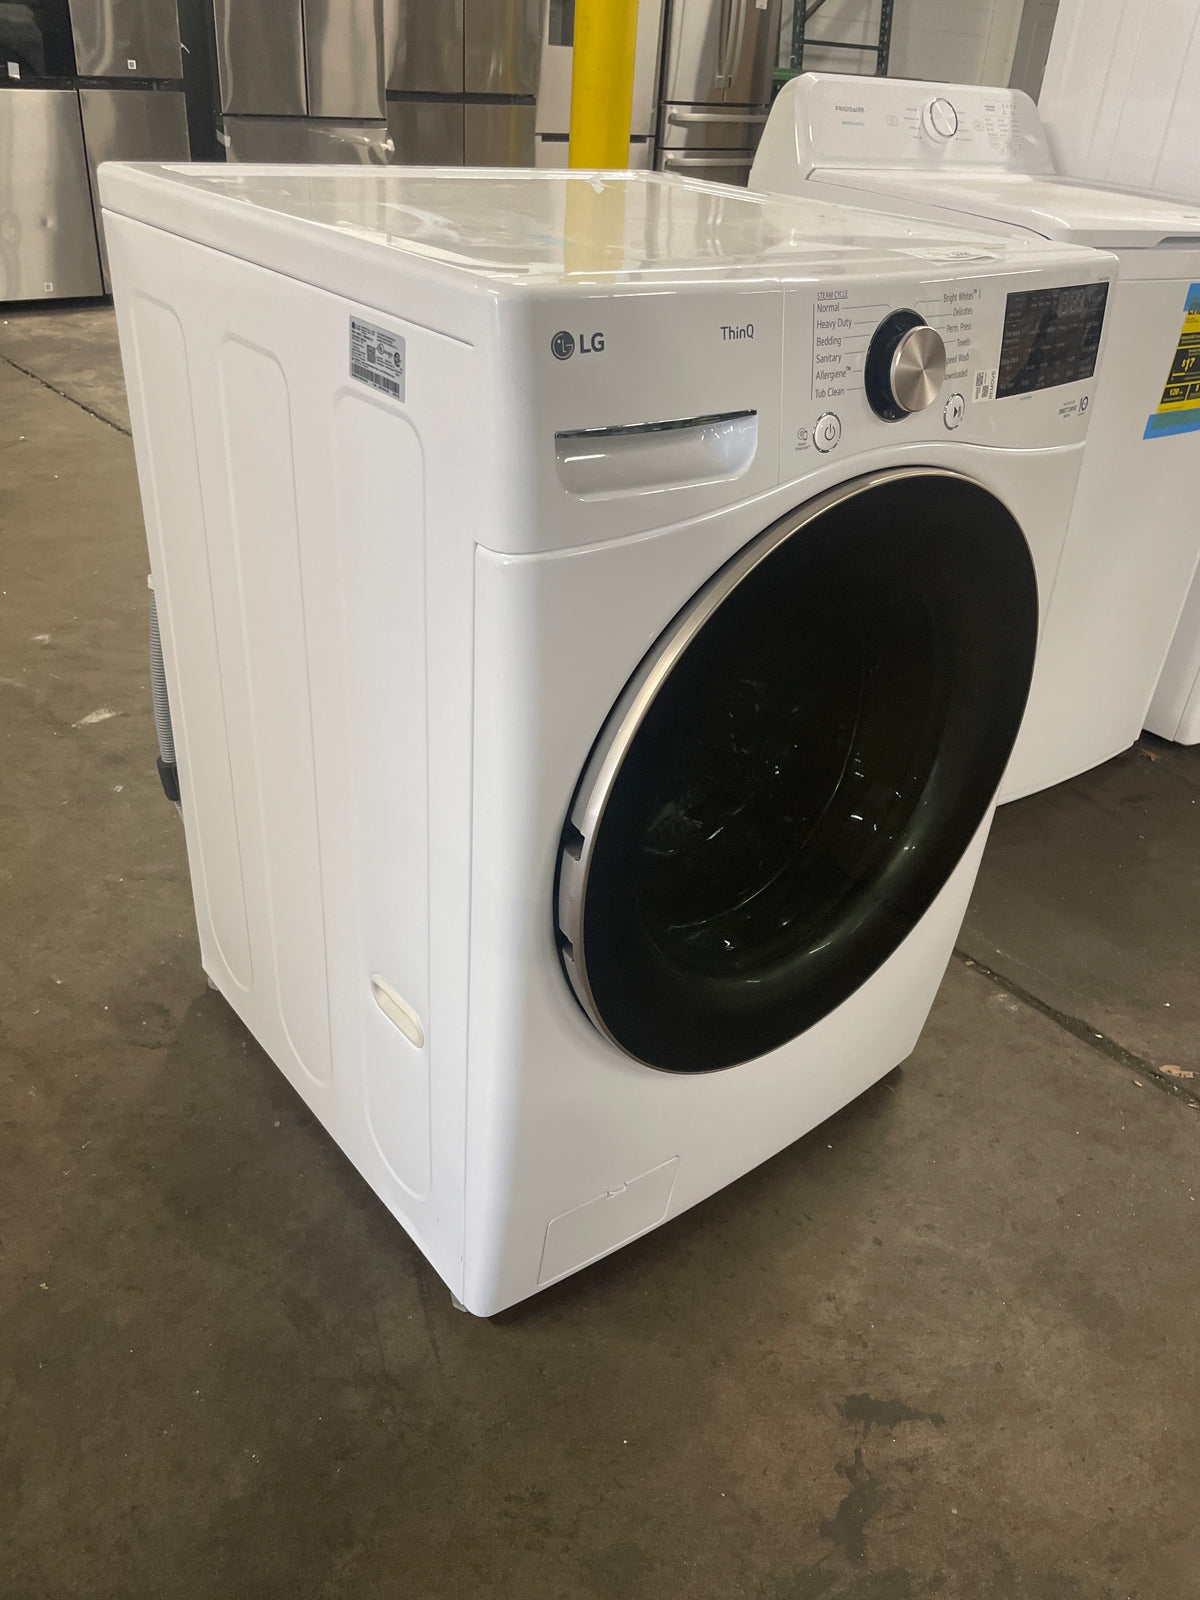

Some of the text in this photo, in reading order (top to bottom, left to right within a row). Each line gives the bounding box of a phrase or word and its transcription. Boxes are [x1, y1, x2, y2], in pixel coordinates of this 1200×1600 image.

[817, 290, 848, 300] STEAM CYCLE
[817, 302, 840, 313] Normal
[816, 318, 852, 331] Heavy Duty
[720, 324, 754, 341] ThinQ
[579, 332, 605, 354] LG
[816, 336, 842, 348] Bedding
[816, 353, 842, 364] Sanitary
[815, 387, 845, 398] Tub Clean
